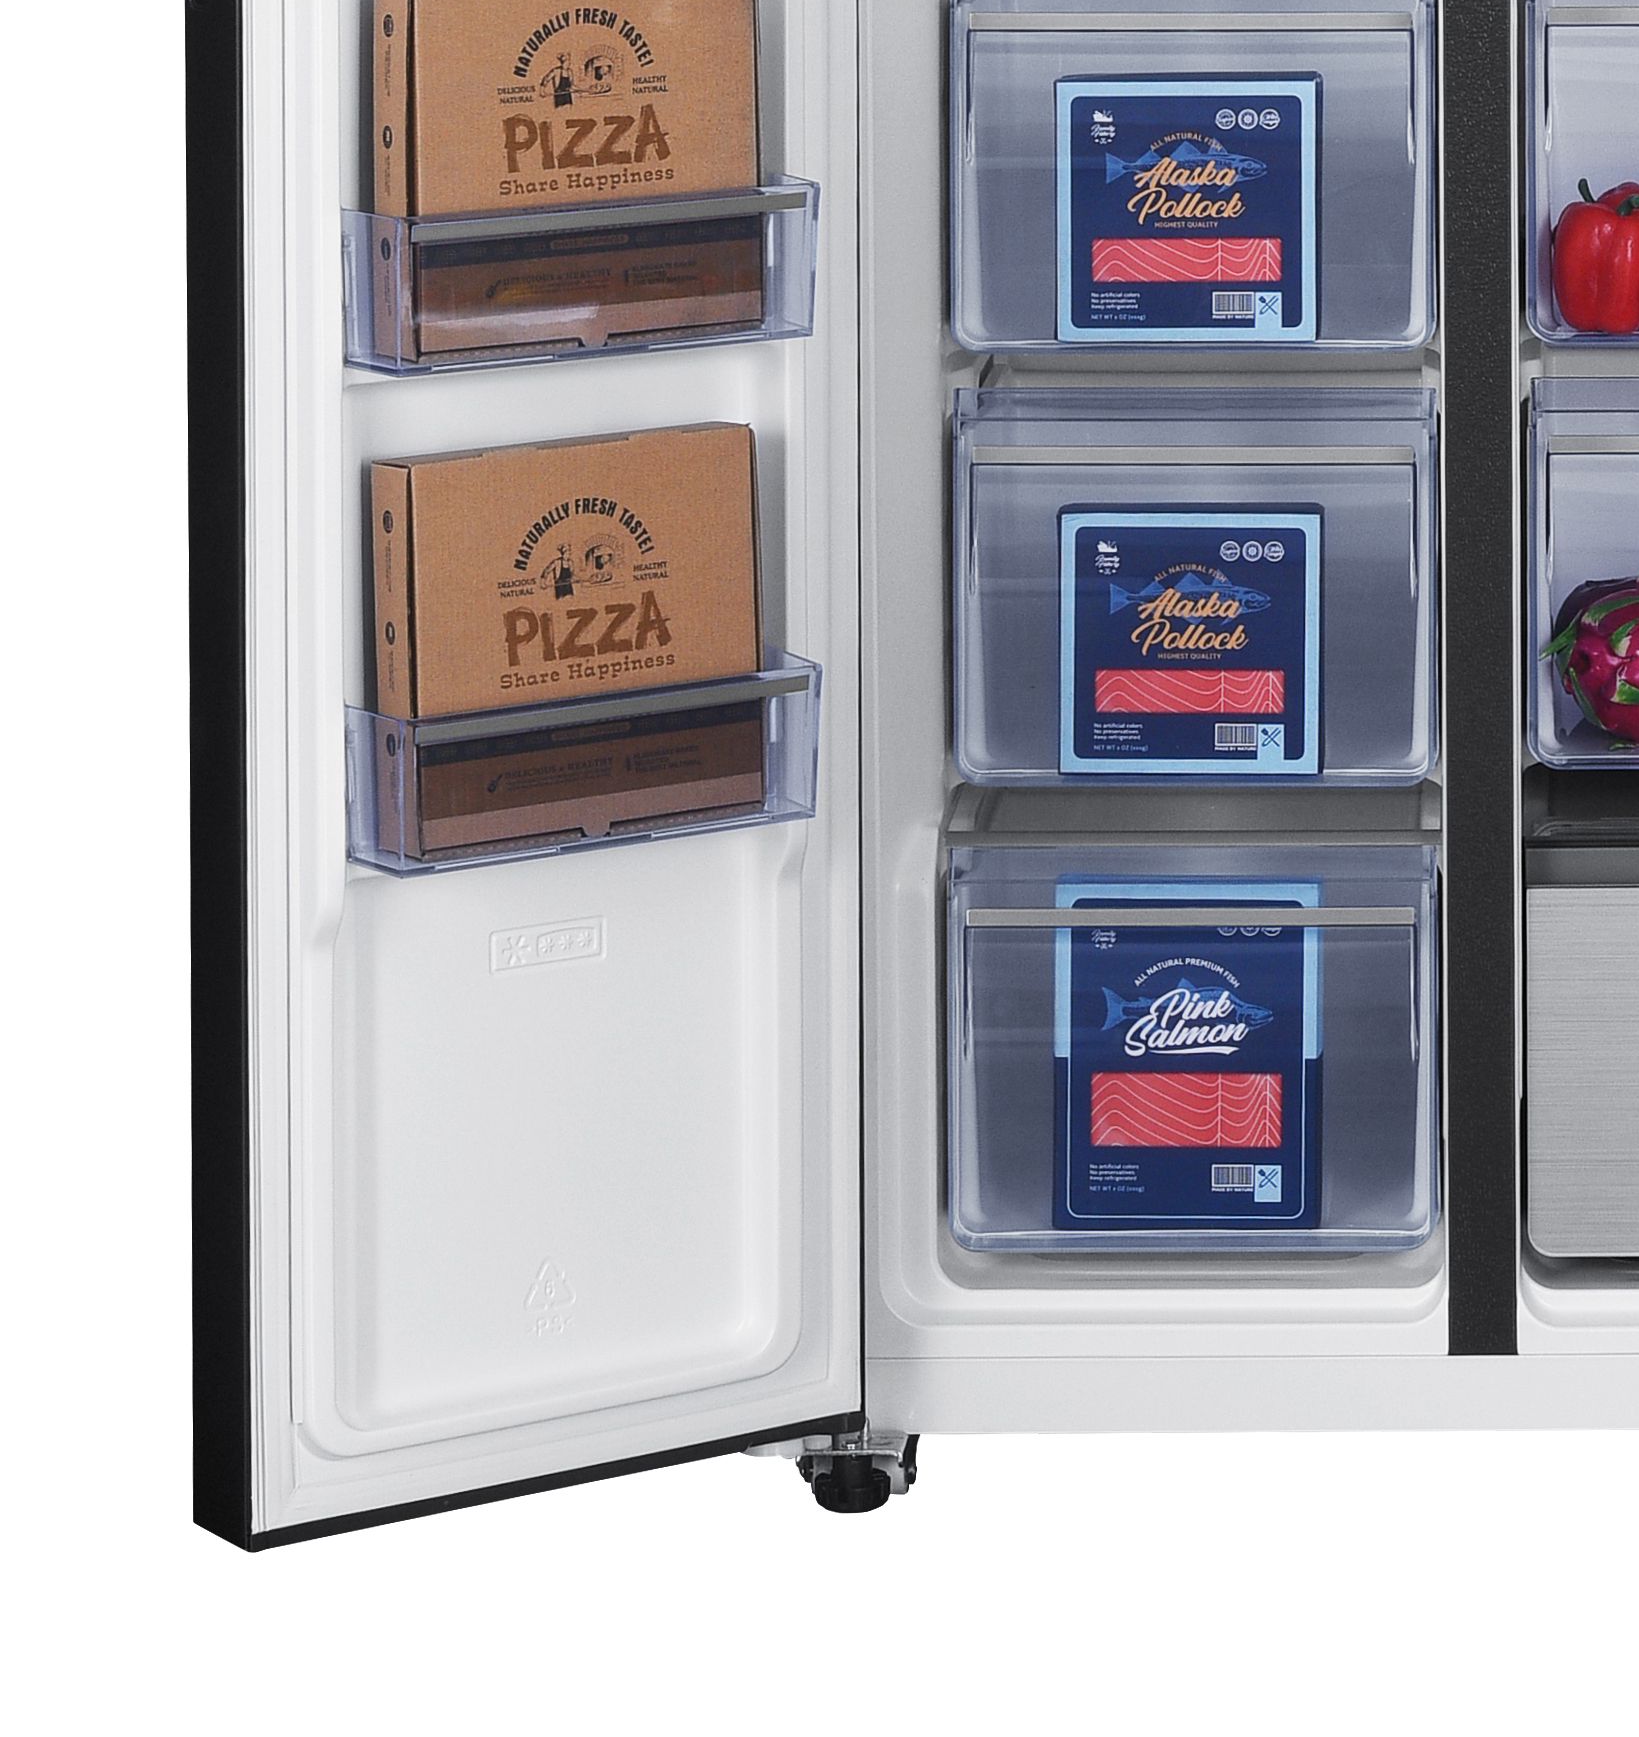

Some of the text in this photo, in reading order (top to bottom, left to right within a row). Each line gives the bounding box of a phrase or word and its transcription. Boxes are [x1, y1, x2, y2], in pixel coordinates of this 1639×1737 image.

[513, 7, 655, 78] NATURALLY FRESH TASTE!
[497, 85, 536, 95] DELICIOUS
[631, 85, 669, 95] NATURAL
[632, 75, 668, 85] HEALTHY
[499, 95, 535, 105] NATURAL
[502, 103, 671, 174] PIZZA
[1150, 132, 1223, 151] ALL NATURAL FISH
[500, 168, 675, 196] Share Happiness
[1133, 156, 1239, 189] Alaska
[1127, 187, 1246, 225] Pollock
[1186, 221, 1219, 229] QUALITY
[513, 497, 655, 571] NATURALLY FRESH TASTE!
[632, 571, 669, 581] NATURAL
[633, 561, 668, 572] HEALTHY
[1154, 563, 1227, 583] ALL NATURAL FISH
[498, 577, 537, 589] DELICIOUS
[500, 588, 535, 599] NATURAL
[1137, 587, 1243, 620] Alaska
[502, 590, 672, 668] PIZZA
[1131, 618, 1249, 656] Pollock
[500, 654, 675, 690] Share Happiness
[1134, 957, 1241, 988] ALL NATURAL PREMIUM FISH
[1149, 987, 1236, 1029] Pink
[1124, 1014, 1250, 1057] Salmon
